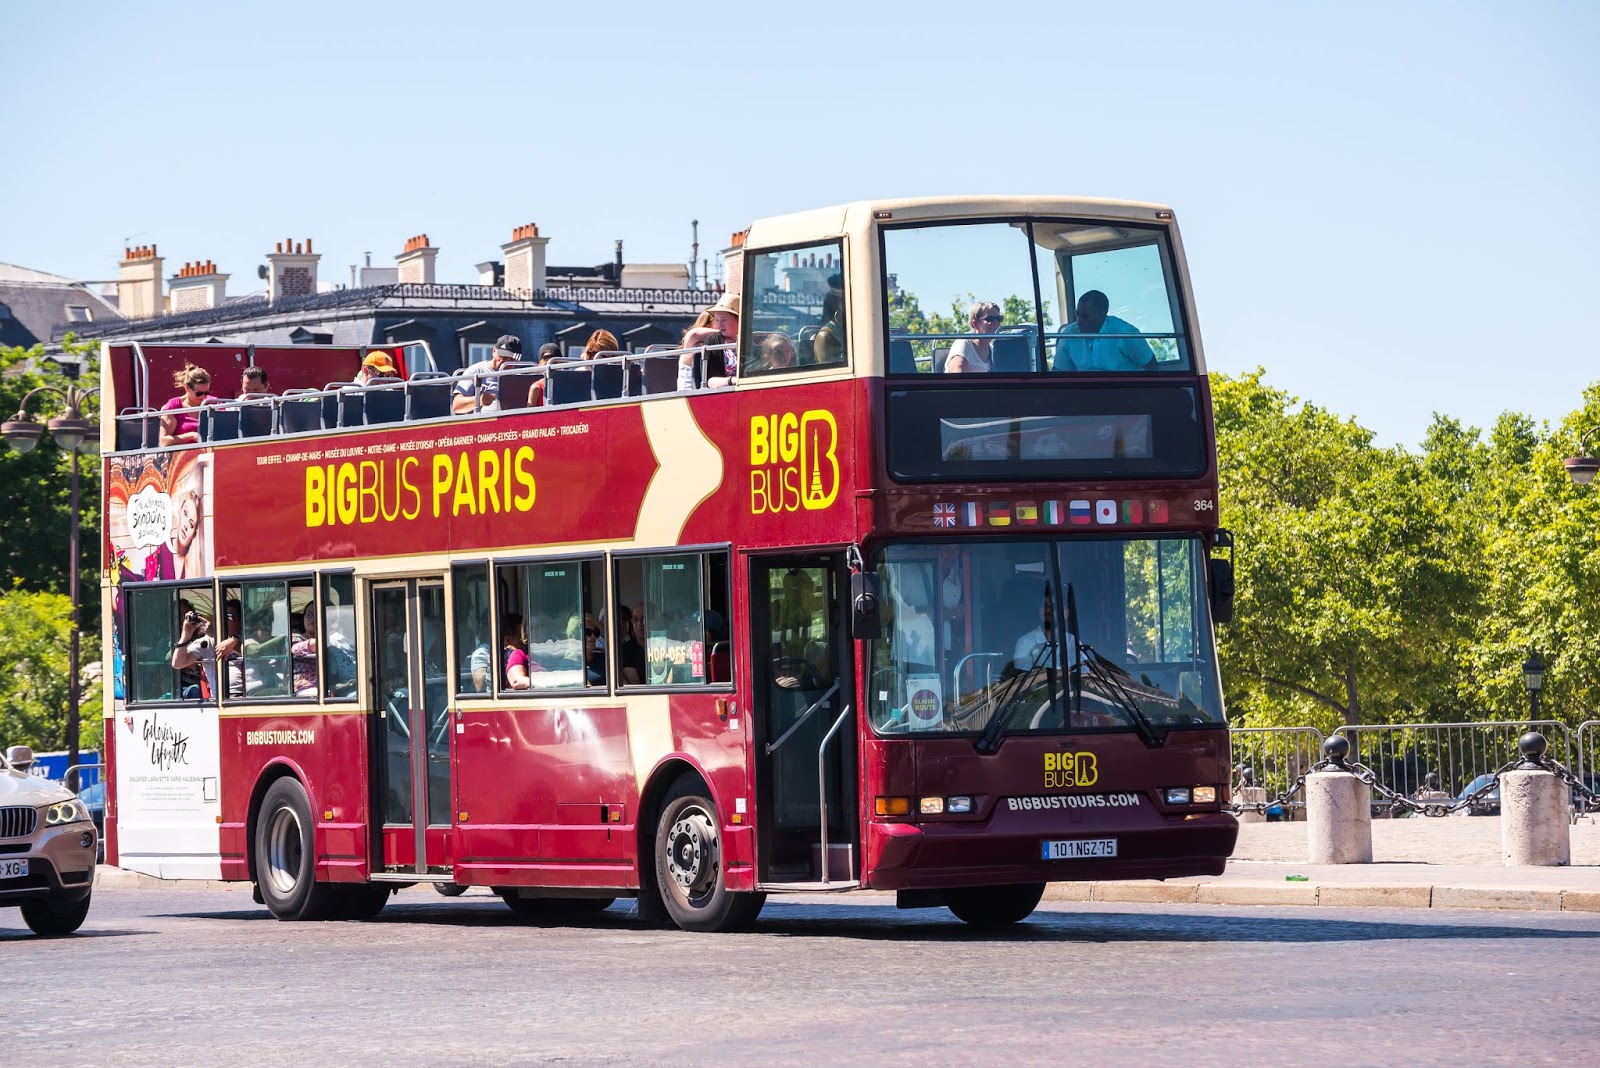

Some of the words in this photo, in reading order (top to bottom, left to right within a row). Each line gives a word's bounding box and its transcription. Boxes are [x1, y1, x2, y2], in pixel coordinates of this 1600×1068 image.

[256, 456, 268, 466] TOUR
[268, 454, 283, 465] EIFFEL
[285, 450, 322, 463] CHAMP-DE-MARS
[324, 447, 340, 459] MUSÉE
[339, 449, 347, 458] DU
[346, 446, 364, 457] LOUVRE
[367, 443, 397, 454] NOTRE-DAME
[400, 440, 415, 451] MUSÉE
[415, 438, 435, 450] D'ORSAY
[437, 436, 454, 448] OPÉRA
[453, 435, 474, 446] GARNIER
[477, 429, 518, 444] CHAMPS-ELYSÉES
[521, 428, 539, 439] GRAND
[539, 427, 556, 438] PALAIS
[560, 422, 589, 436] TROCADÉRO
[750, 412, 799, 466] BIG
[432, 445, 537, 519] PARIS
[750, 466, 800, 515] BUS
[1193, 499, 1214, 511] 364
[246, 730, 315, 746] BIGBUSTOURS.COM
[1044, 752, 1074, 771] BIG
[1044, 770, 1075, 788] BUS
[1007, 793, 1141, 811] BIGBUSTOURS.COM
